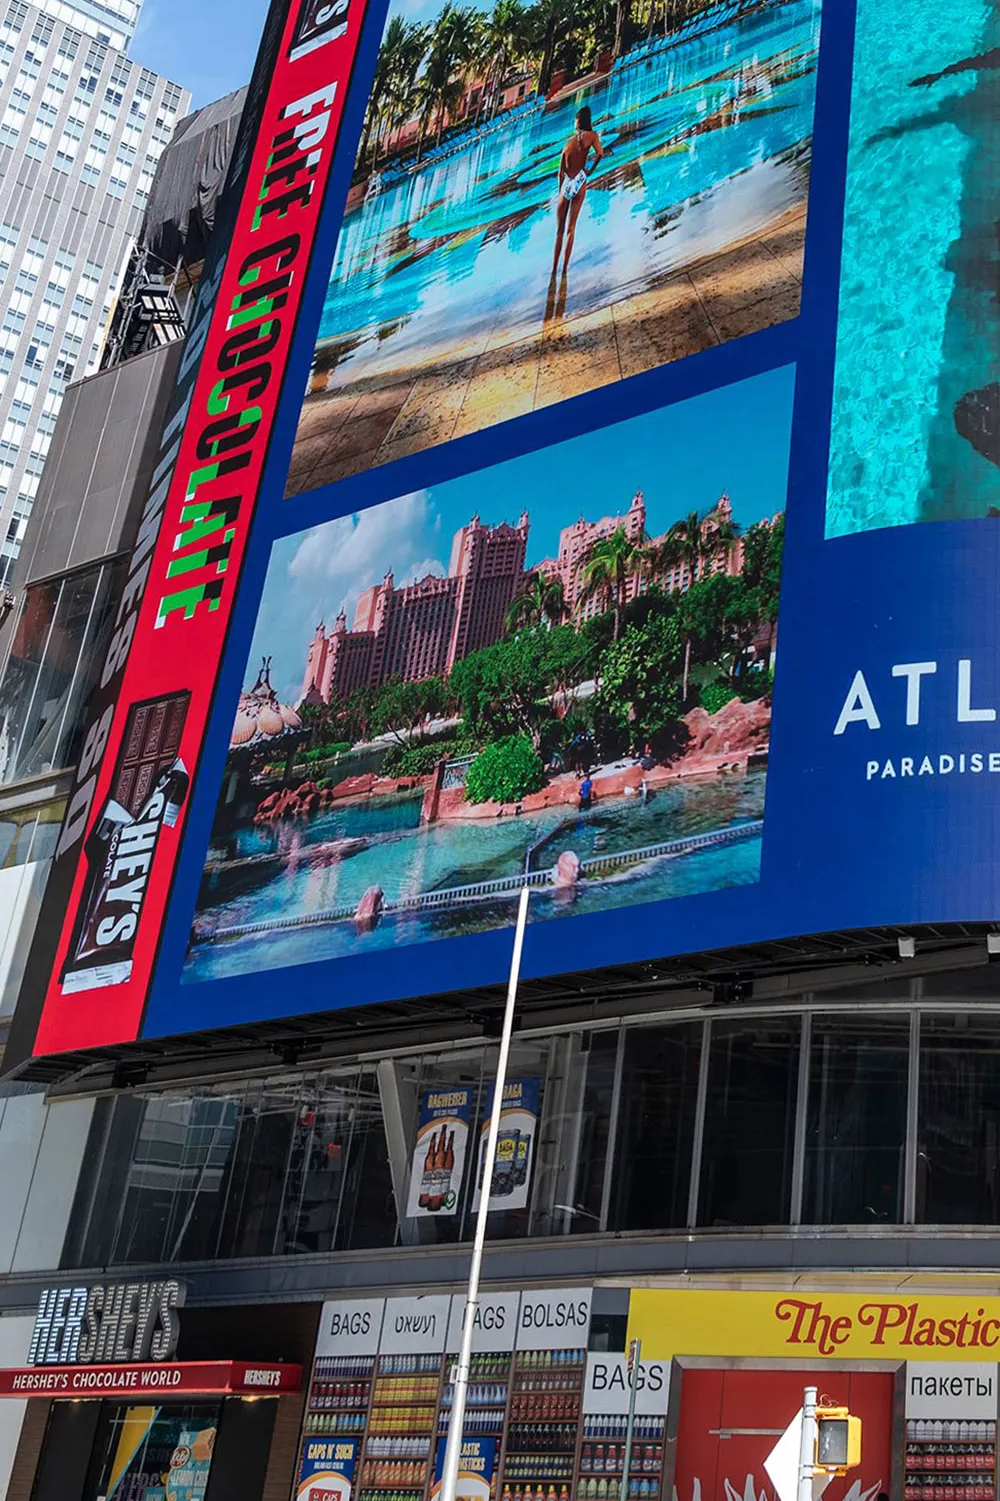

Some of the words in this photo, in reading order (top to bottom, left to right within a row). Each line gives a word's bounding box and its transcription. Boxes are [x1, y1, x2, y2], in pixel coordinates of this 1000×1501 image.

[250, 80, 339, 233] FREE
[154, 232, 299, 630] CHOCOLATE
[28, 1279, 187, 1364] HERSHEY'S
[330, 1312, 371, 1336] BAGS
[522, 1302, 588, 1328] BOLSAS
[775, 1298, 852, 1355] The
[858, 1302, 1000, 1348] Plastic
[12, 1372, 68, 1389] HERSHEY'S
[73, 1371, 138, 1388] CHOCOLATE
[141, 1370, 181, 1386] WORLD
[244, 1369, 281, 1386] HERSHEY'S
[592, 1364, 663, 1391] BAGS
[910, 1374, 993, 1397] пакеты
